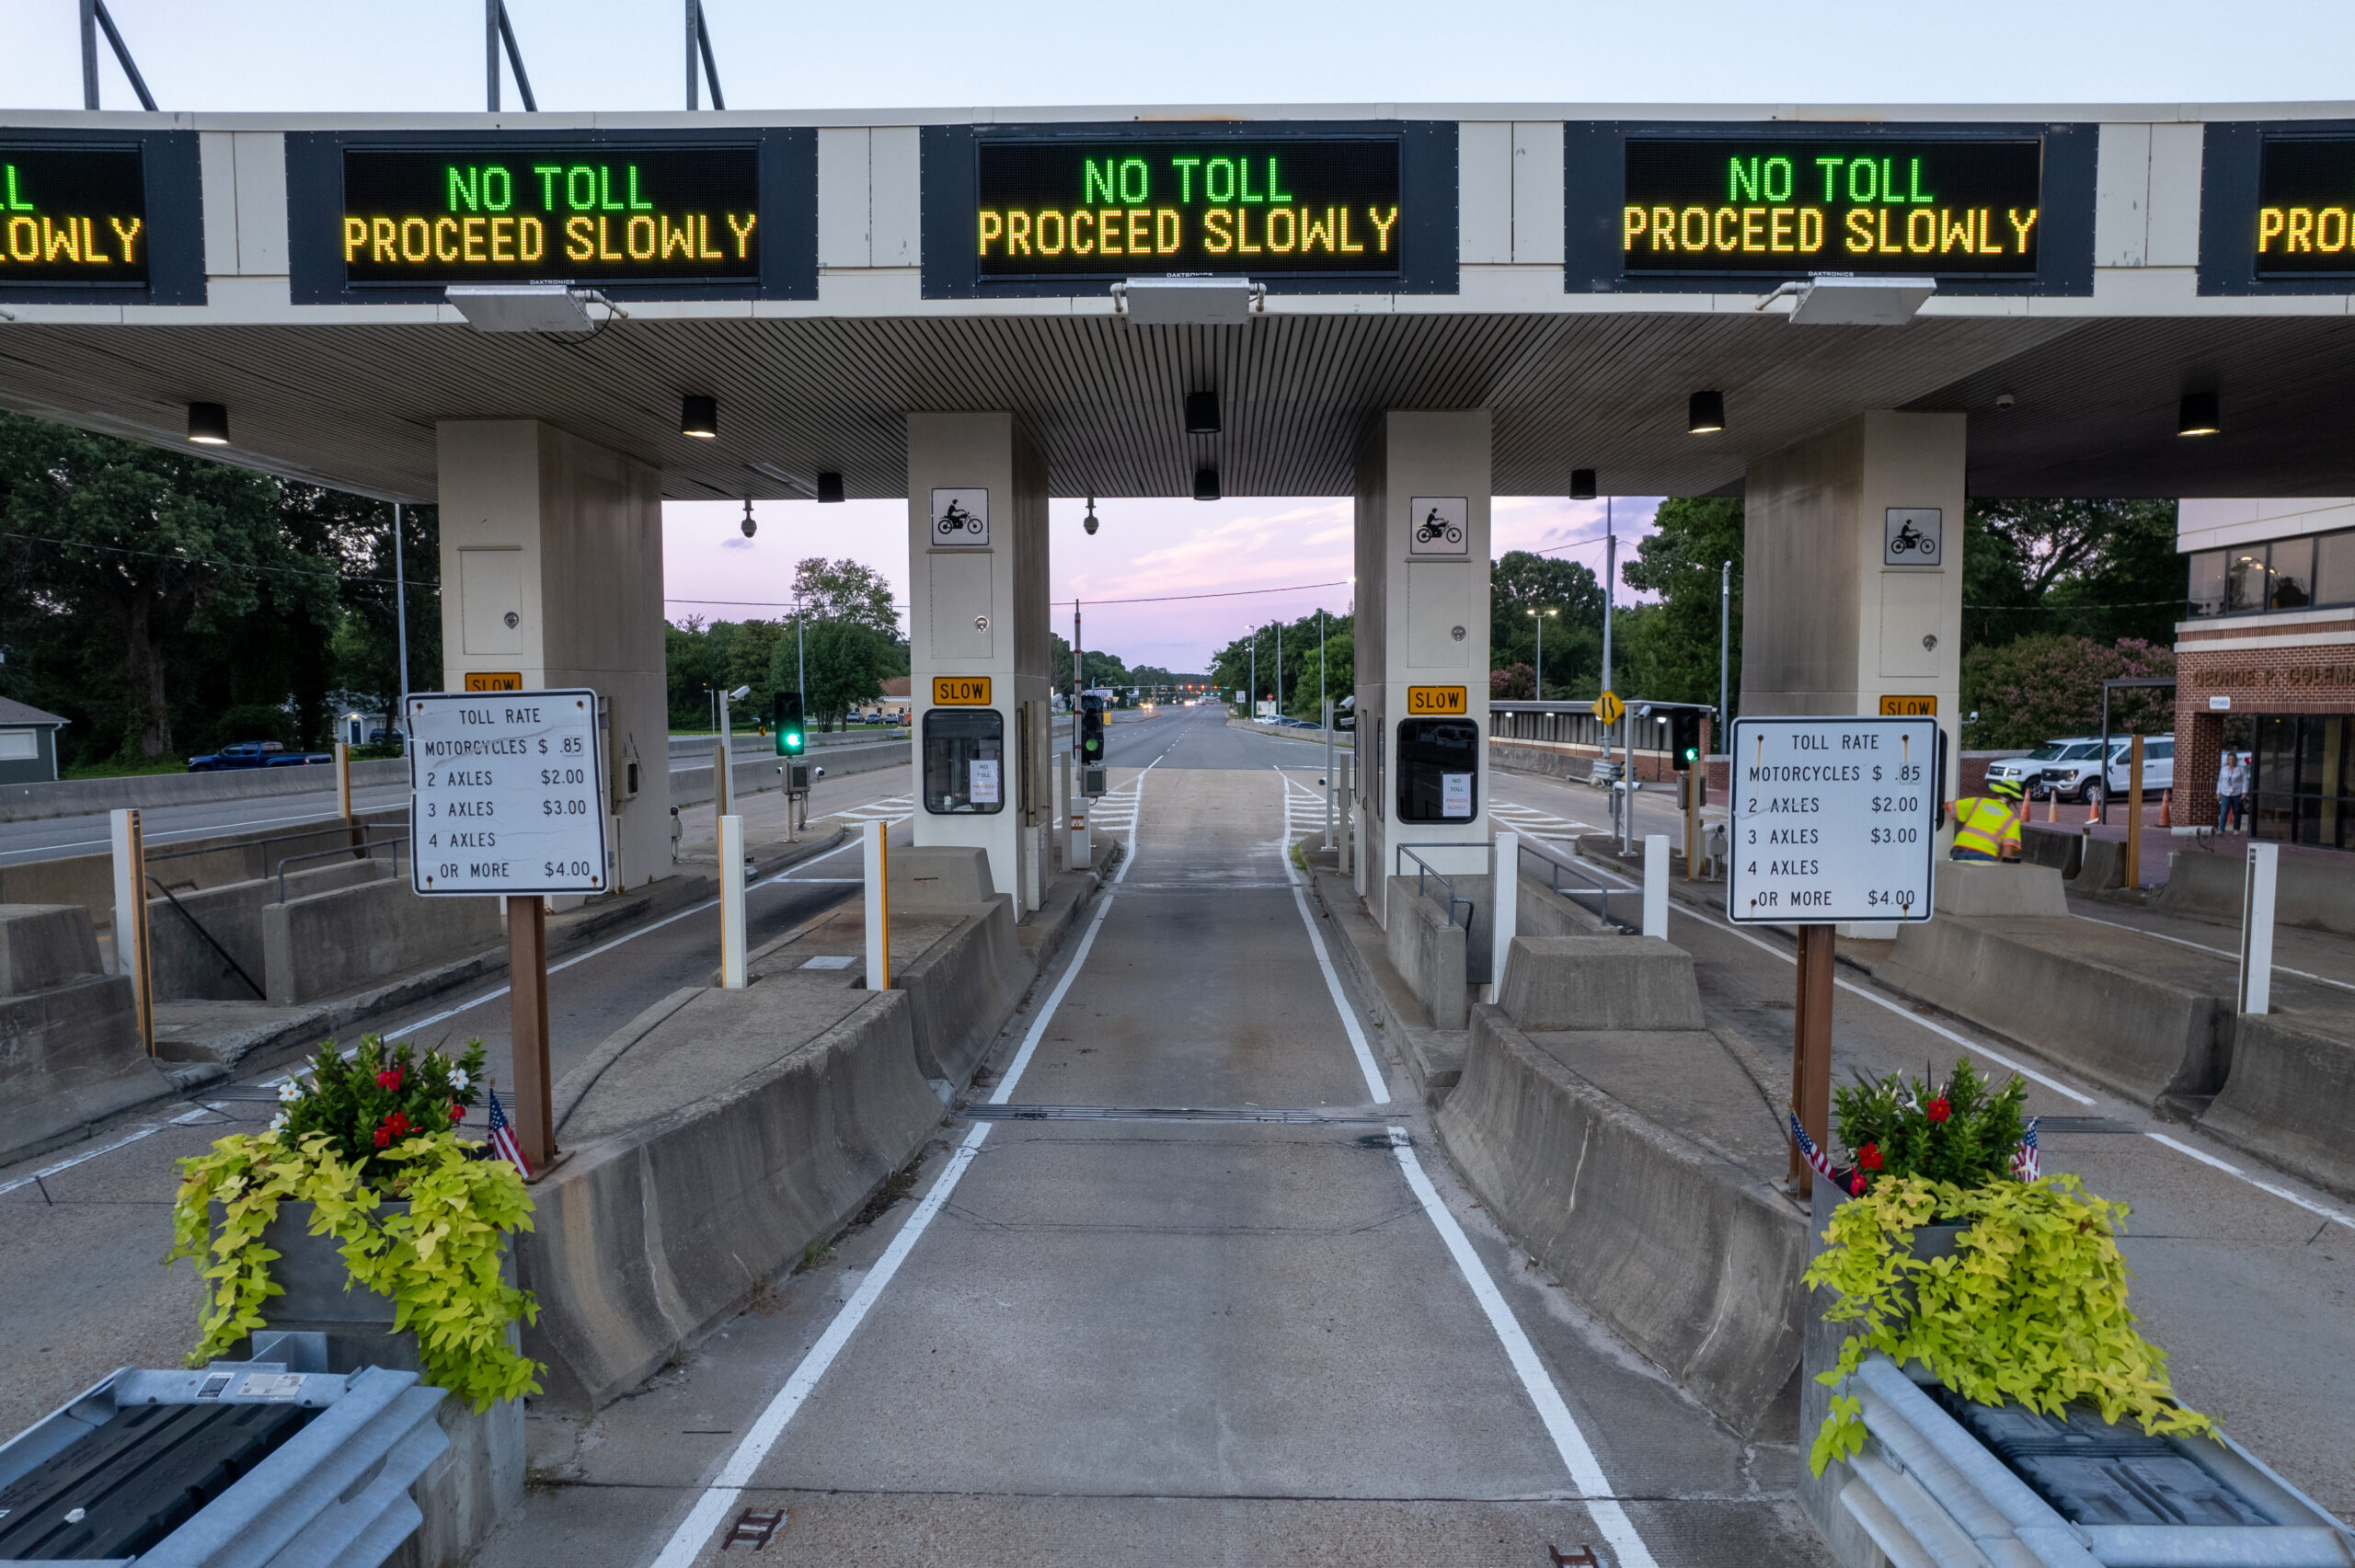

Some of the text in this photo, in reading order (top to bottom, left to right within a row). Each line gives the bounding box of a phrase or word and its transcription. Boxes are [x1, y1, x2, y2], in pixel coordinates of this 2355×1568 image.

[1086, 157, 1292, 204] NO TOLL
[1730, 157, 1934, 203] NO TOLL
[449, 166, 653, 212] NO TOLL
[343, 213, 757, 263] PROCEED SLOWLY
[979, 207, 1398, 257] PROCEED SLOWLY
[1624, 207, 2039, 254] PROCEED SLOWLY
[2258, 208, 2355, 253] PRO
[0, 217, 142, 263] OWLY
[940, 683, 984, 700] SLOW
[1415, 692, 1460, 708] SLOW
[459, 708, 541, 725] TOLL RATE
[425, 739, 527, 756] MOTORCYCLES
[1792, 735, 1879, 750] TOLL RATE
[428, 769, 584, 786] 2 AXLES $2.00
[1749, 766, 1860, 782] MOTORCYCLES
[428, 800, 586, 817] 3 AXLES $3.00
[1749, 796, 1918, 813] 2 AXLES $2.00
[429, 832, 496, 848] 4 AXLES
[1748, 828, 1917, 844] 3 AXLES $3.00
[440, 861, 590, 878] OR MORE $4.00
[1748, 860, 1819, 876] 4 AXLES
[1758, 889, 1914, 906] OR MORE $4.00
